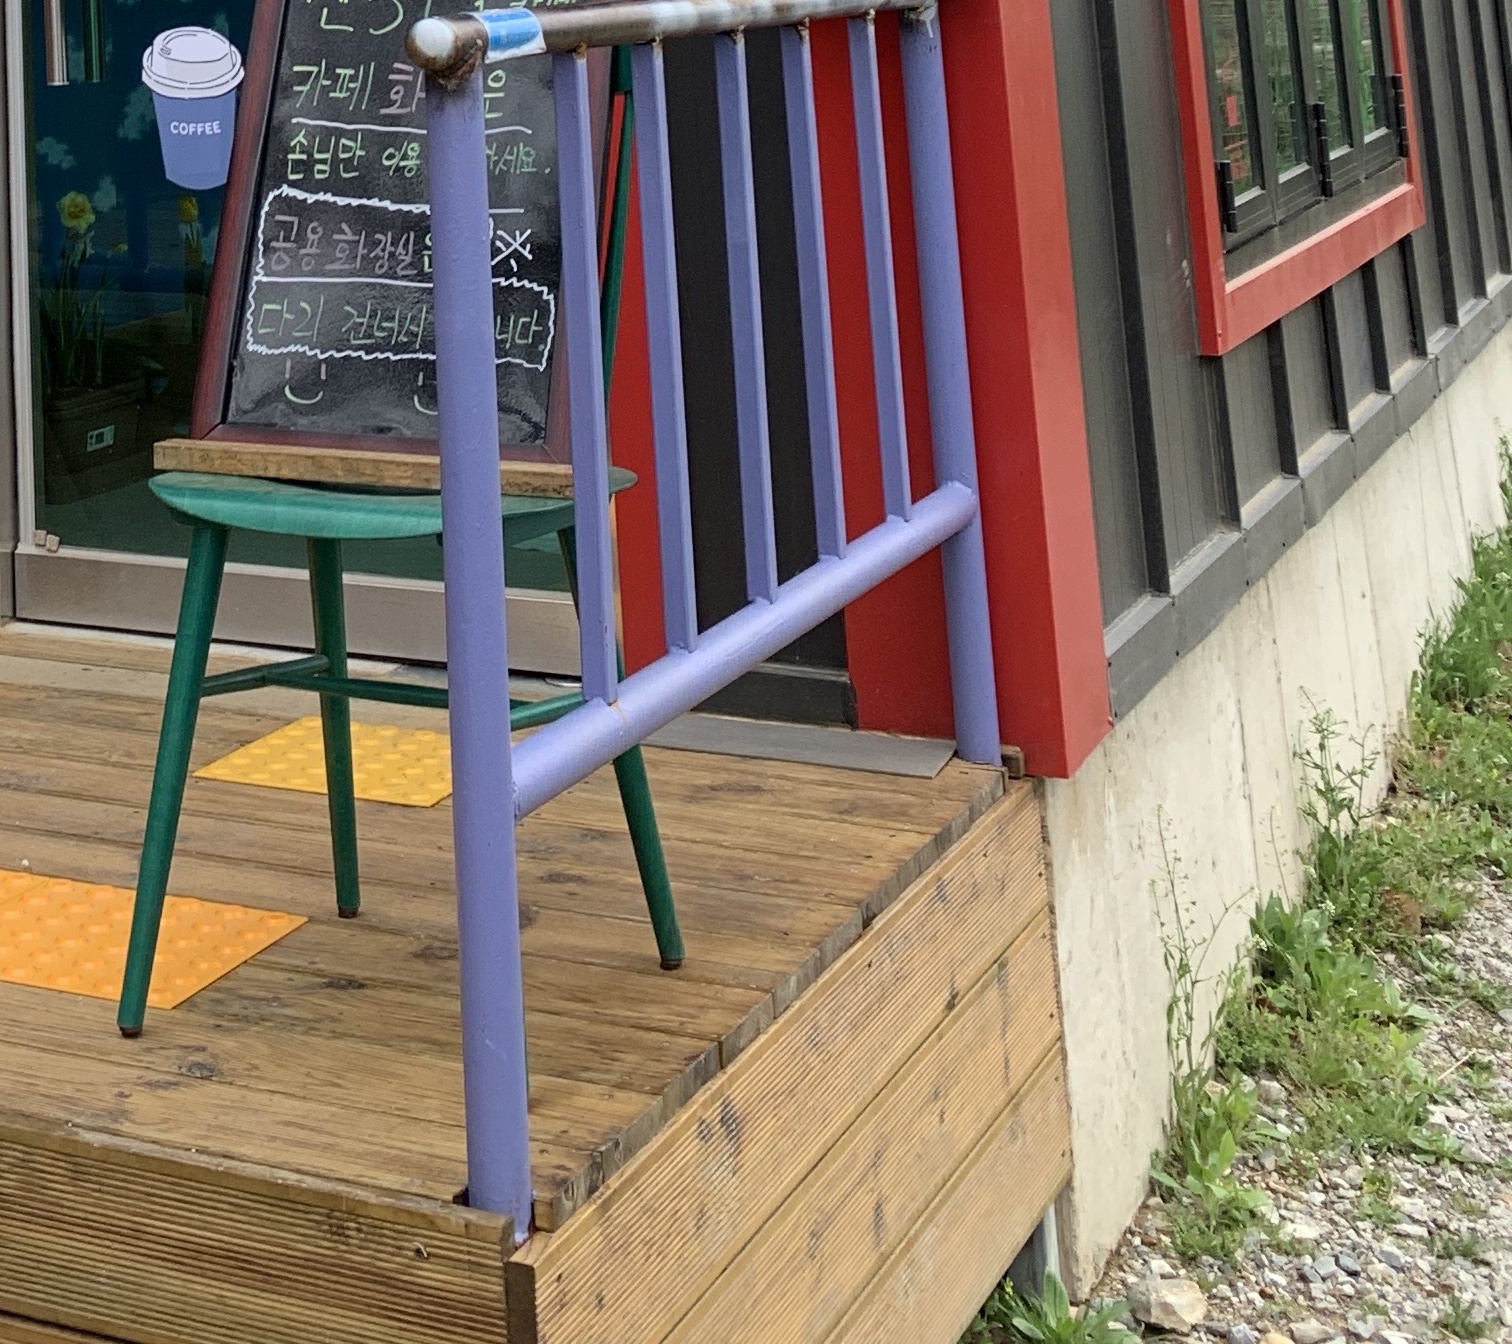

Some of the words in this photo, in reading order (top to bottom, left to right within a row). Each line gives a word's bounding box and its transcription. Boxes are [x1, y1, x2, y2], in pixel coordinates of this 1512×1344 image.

[292, 59, 375, 111] 카페
[170, 120, 222, 136] COFFEE
[287, 128, 366, 180] 손님만
[257, 295, 325, 343] 다리
[341, 301, 428, 350] 건너서
